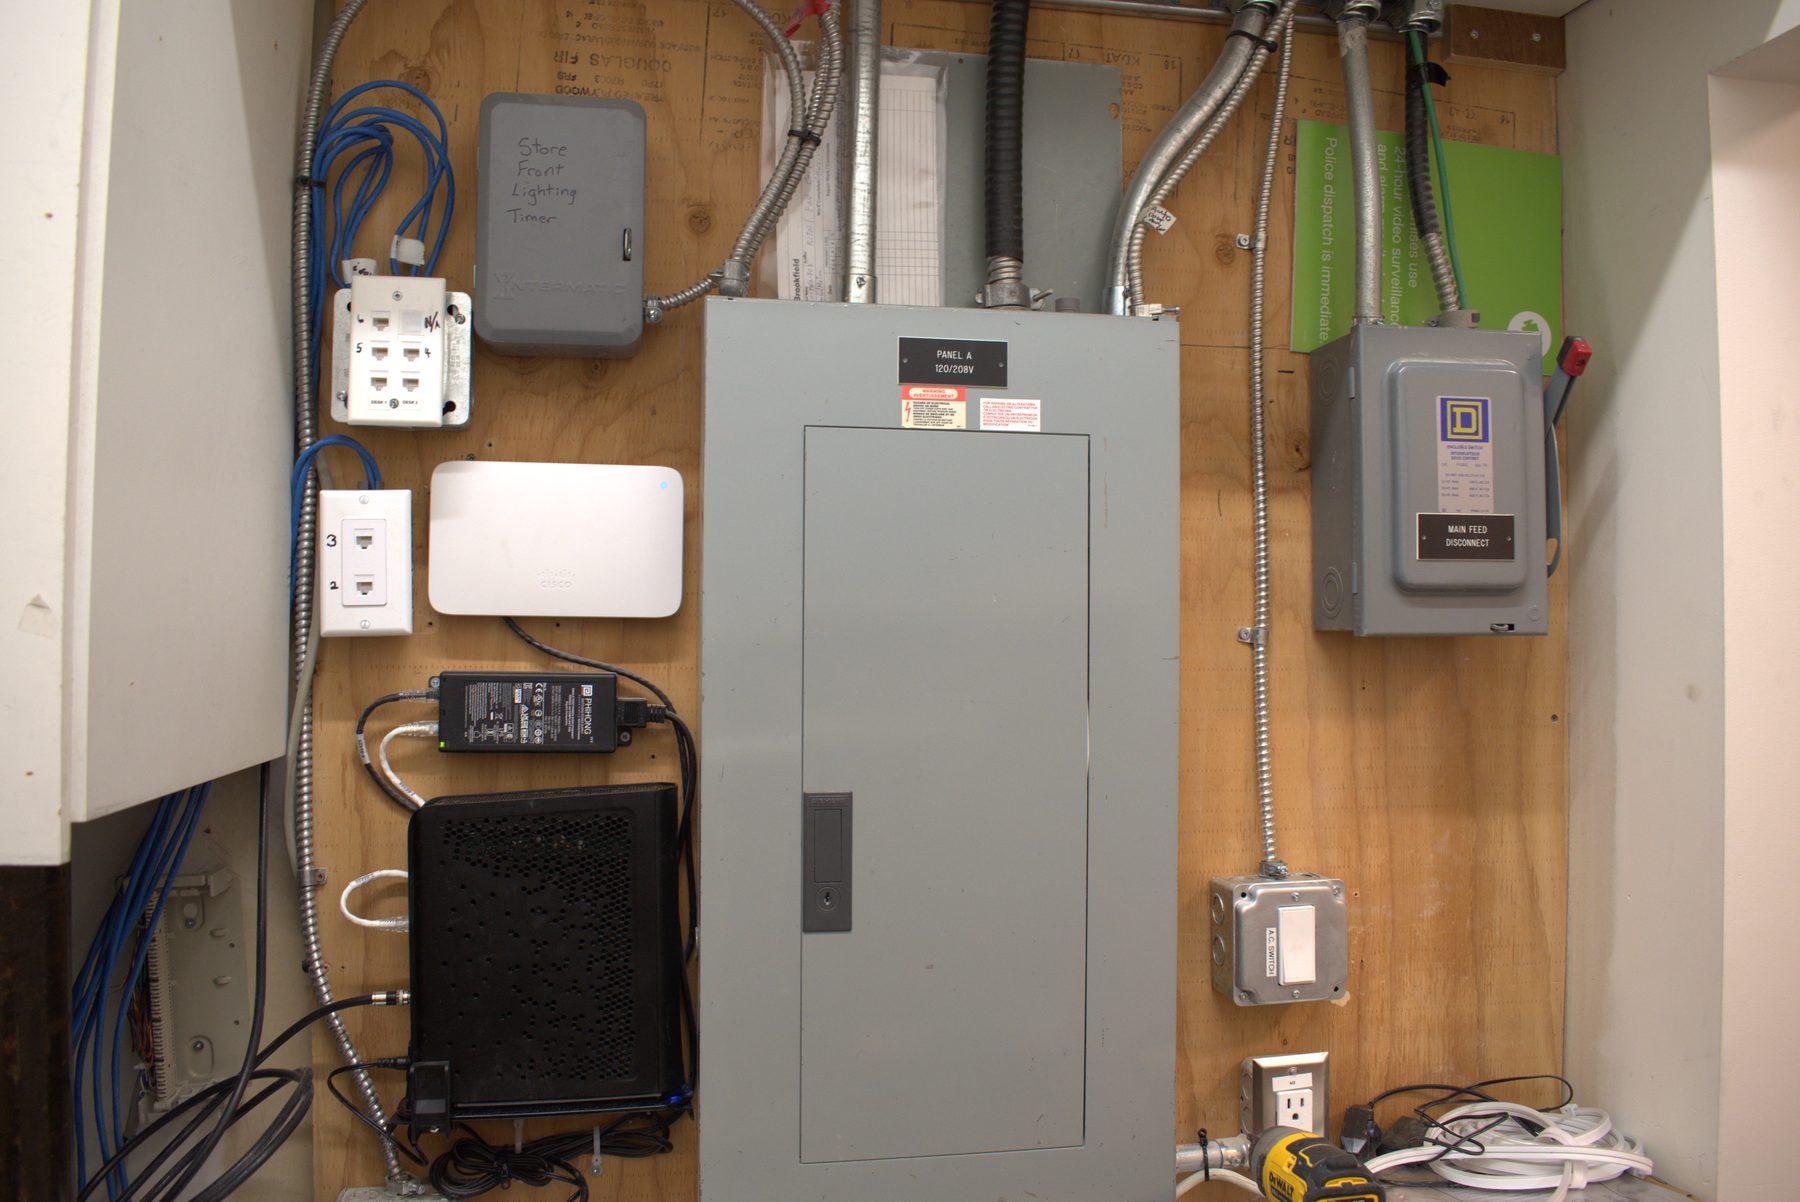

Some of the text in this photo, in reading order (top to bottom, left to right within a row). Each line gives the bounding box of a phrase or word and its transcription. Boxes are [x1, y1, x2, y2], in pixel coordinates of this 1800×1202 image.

[552, 50, 672, 73] FIR DOUGLAS
[518, 137, 568, 156] Store
[517, 160, 565, 176] Front
[1393, 146, 1406, 201] 24-hour
[512, 184, 577, 206] Lighting
[506, 208, 558, 224] Timer
[1392, 206, 1403, 244] video
[1319, 138, 1338, 344] Police dispatch is immediate.
[1408, 263, 1417, 288] use
[424, 311, 441, 333] N/A
[356, 342, 363, 353] 5
[425, 347, 431, 358] 4
[937, 350, 972, 360] PANEL A
[935, 364, 974, 374] 120/208V
[1448, 525, 1488, 534] MAIN FEED
[326, 534, 337, 547] 3
[1446, 538, 1490, 547] DISCONNECT
[330, 581, 338, 590] 2
[583, 698, 592, 735] PHIHONG
